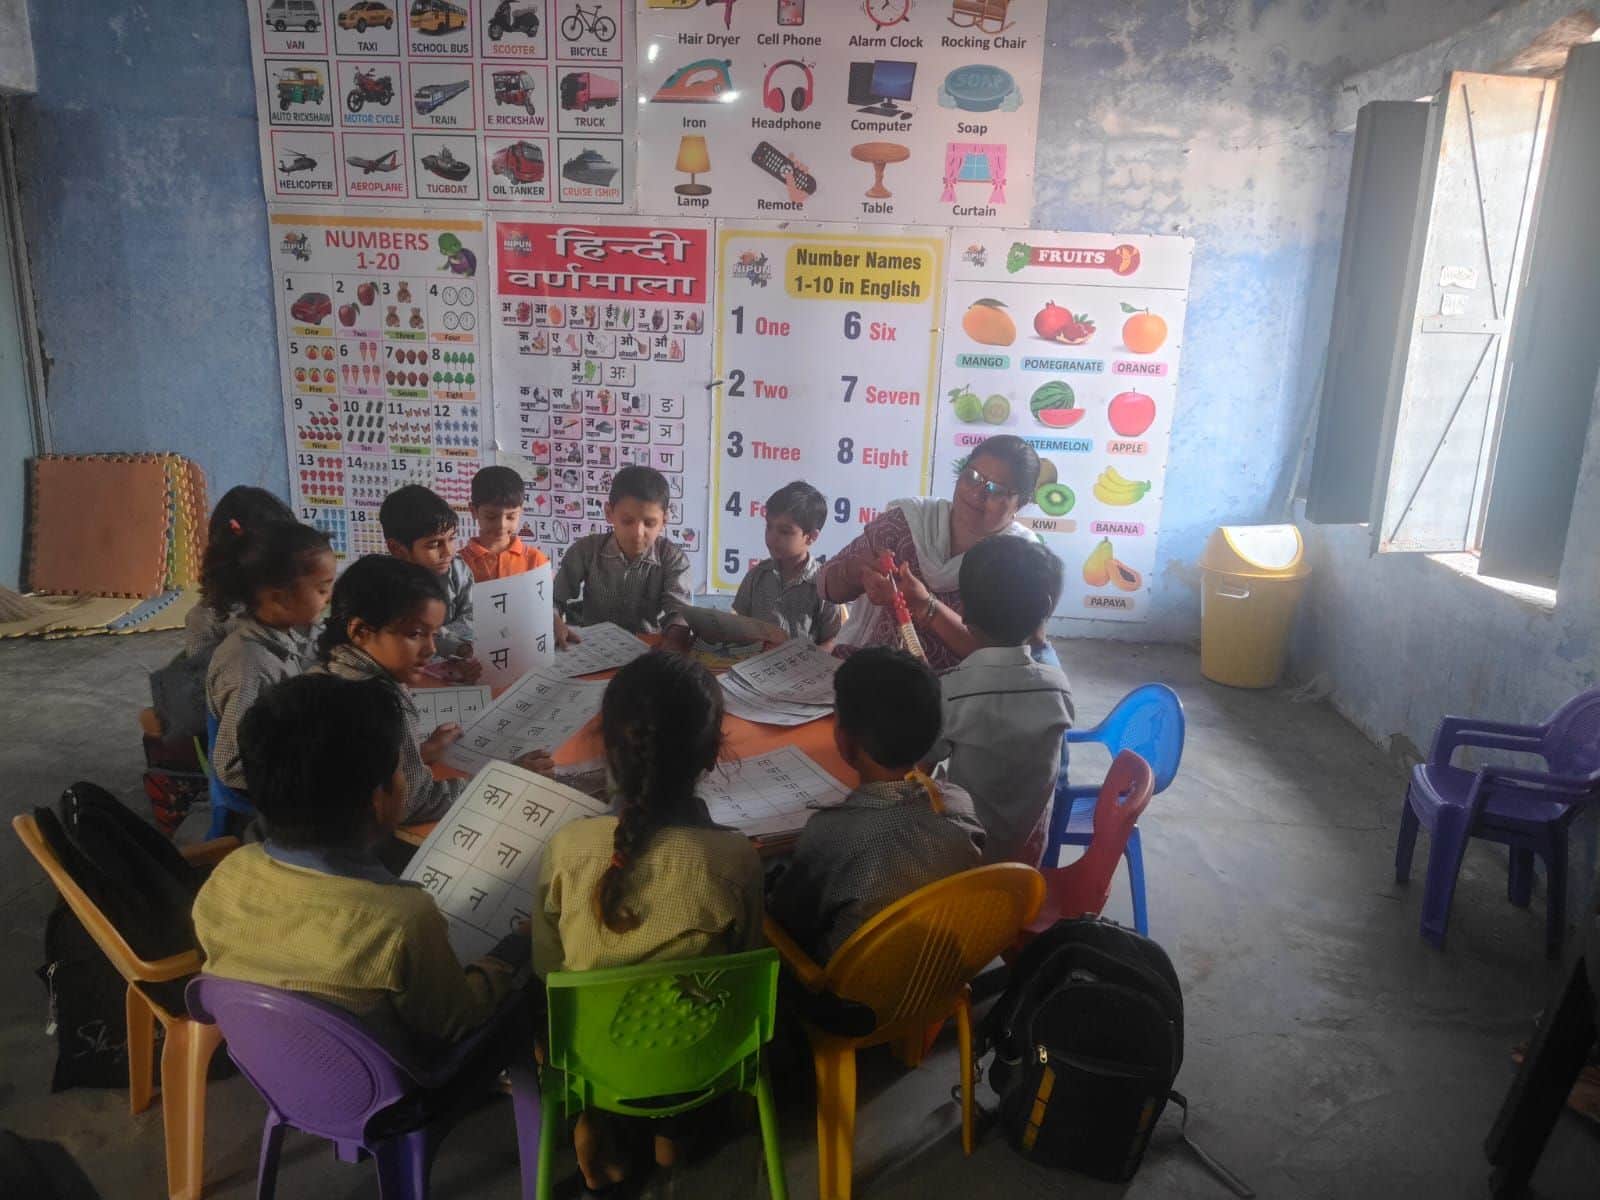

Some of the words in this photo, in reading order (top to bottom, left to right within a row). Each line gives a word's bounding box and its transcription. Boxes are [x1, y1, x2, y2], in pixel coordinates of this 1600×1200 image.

[286, 41, 304, 50] VAN
[678, 33, 703, 45] Hair
[707, 34, 740, 48] Dryer
[757, 34, 780, 45] Cell
[784, 34, 822, 46] Phone
[849, 35, 886, 48] Alarm
[889, 36, 923, 49] Clock
[941, 36, 992, 51] Rocking
[995, 37, 1026, 49] Chair
[358, 42, 378, 51] TAXI
[412, 43, 447, 53] SCHOOL
[450, 44, 468, 53] BUS
[493, 45, 535, 55] SCOOTER
[570, 47, 608, 57] BICYCLE
[272, 112, 292, 122] AUTO
[292, 112, 330, 123] RICKSHAW
[344, 114, 372, 123] MOTOR
[375, 114, 400, 124] CYCLE
[430, 115, 457, 125] TRAIN
[488, 116, 493, 124] E
[497, 115, 544, 126] RICKSHAW
[575, 117, 605, 127] TRUCK
[683, 117, 706, 128] Iron
[752, 117, 821, 132] Headphone
[851, 120, 912, 134] Computer
[957, 122, 987, 136] Soap
[280, 180, 333, 190] HELICOPTER
[351, 182, 403, 192] AEROPLANE
[427, 184, 468, 194] TUGBOAT
[492, 185, 507, 195] OIL
[509, 186, 544, 196] TANKER
[563, 187, 593, 196] CRUISE
[678, 196, 709, 209] Lamp
[757, 199, 803, 211] Remote
[862, 202, 893, 214] Table
[952, 205, 996, 217] Curtain
[326, 230, 429, 250] NUMBERS
[547, 227, 692, 264] हिन्दी
[357, 252, 400, 270] 1-20
[796, 249, 860, 268] Number
[866, 252, 921, 270] Names
[1038, 250, 1105, 264] FRUITS
[286, 279, 293, 290] 1
[505, 263, 696, 295] वर्णमाला
[336, 281, 344, 293] 2
[383, 283, 390, 294] 3
[430, 284, 438, 296] 4
[795, 275, 833, 293] 1-10
[839, 278, 854, 294] in
[861, 279, 920, 299] English
[502, 303, 511, 312] अ
[535, 304, 547, 313] आ
[639, 308, 645, 318] उ
[732, 306, 743, 334] 1
[756, 317, 790, 336] One
[844, 311, 861, 340] 6
[869, 322, 896, 341] Six
[291, 342, 298, 353] 5
[340, 345, 348, 356] 6
[386, 347, 393, 358] 7
[432, 349, 440, 360] 8
[962, 355, 1003, 367] MANGO
[1025, 359, 1102, 372] POMEGRANATE
[1118, 362, 1161, 374] ORANGE
[728, 369, 745, 397] 2
[753, 380, 788, 399] Two
[520, 387, 530, 395] क
[585, 390, 594, 399] ग
[841, 376, 858, 403] 7
[866, 386, 920, 405] Seven
[295, 399, 302, 409] 9
[344, 401, 359, 412] 10
[388, 403, 404, 414] 11
[435, 405, 450, 416] 12
[585, 418, 595, 427] ज
[727, 431, 743, 457] 3
[752, 441, 800, 461] Three
[1112, 443, 1143, 453] APPLE
[837, 437, 854, 464] 8
[862, 448, 908, 469] Eight
[298, 454, 314, 465] 13
[347, 457, 362, 467] 14
[392, 459, 407, 470] 15
[660, 453, 674, 467] ण
[437, 462, 452, 472] 16
[726, 491, 742, 516] 4
[303, 509, 317, 519] 17
[351, 511, 365, 521] 18
[834, 498, 850, 523] 9
[572, 523, 581, 532] ल
[1032, 520, 1057, 529] KIWI
[1096, 523, 1138, 533] BANANA
[725, 549, 740, 574] 5
[1091, 598, 1126, 609] PAPAYA
[483, 784, 512, 809] का
[523, 800, 554, 828] का
[452, 824, 482, 850] ला
[497, 842, 522, 869] ना
